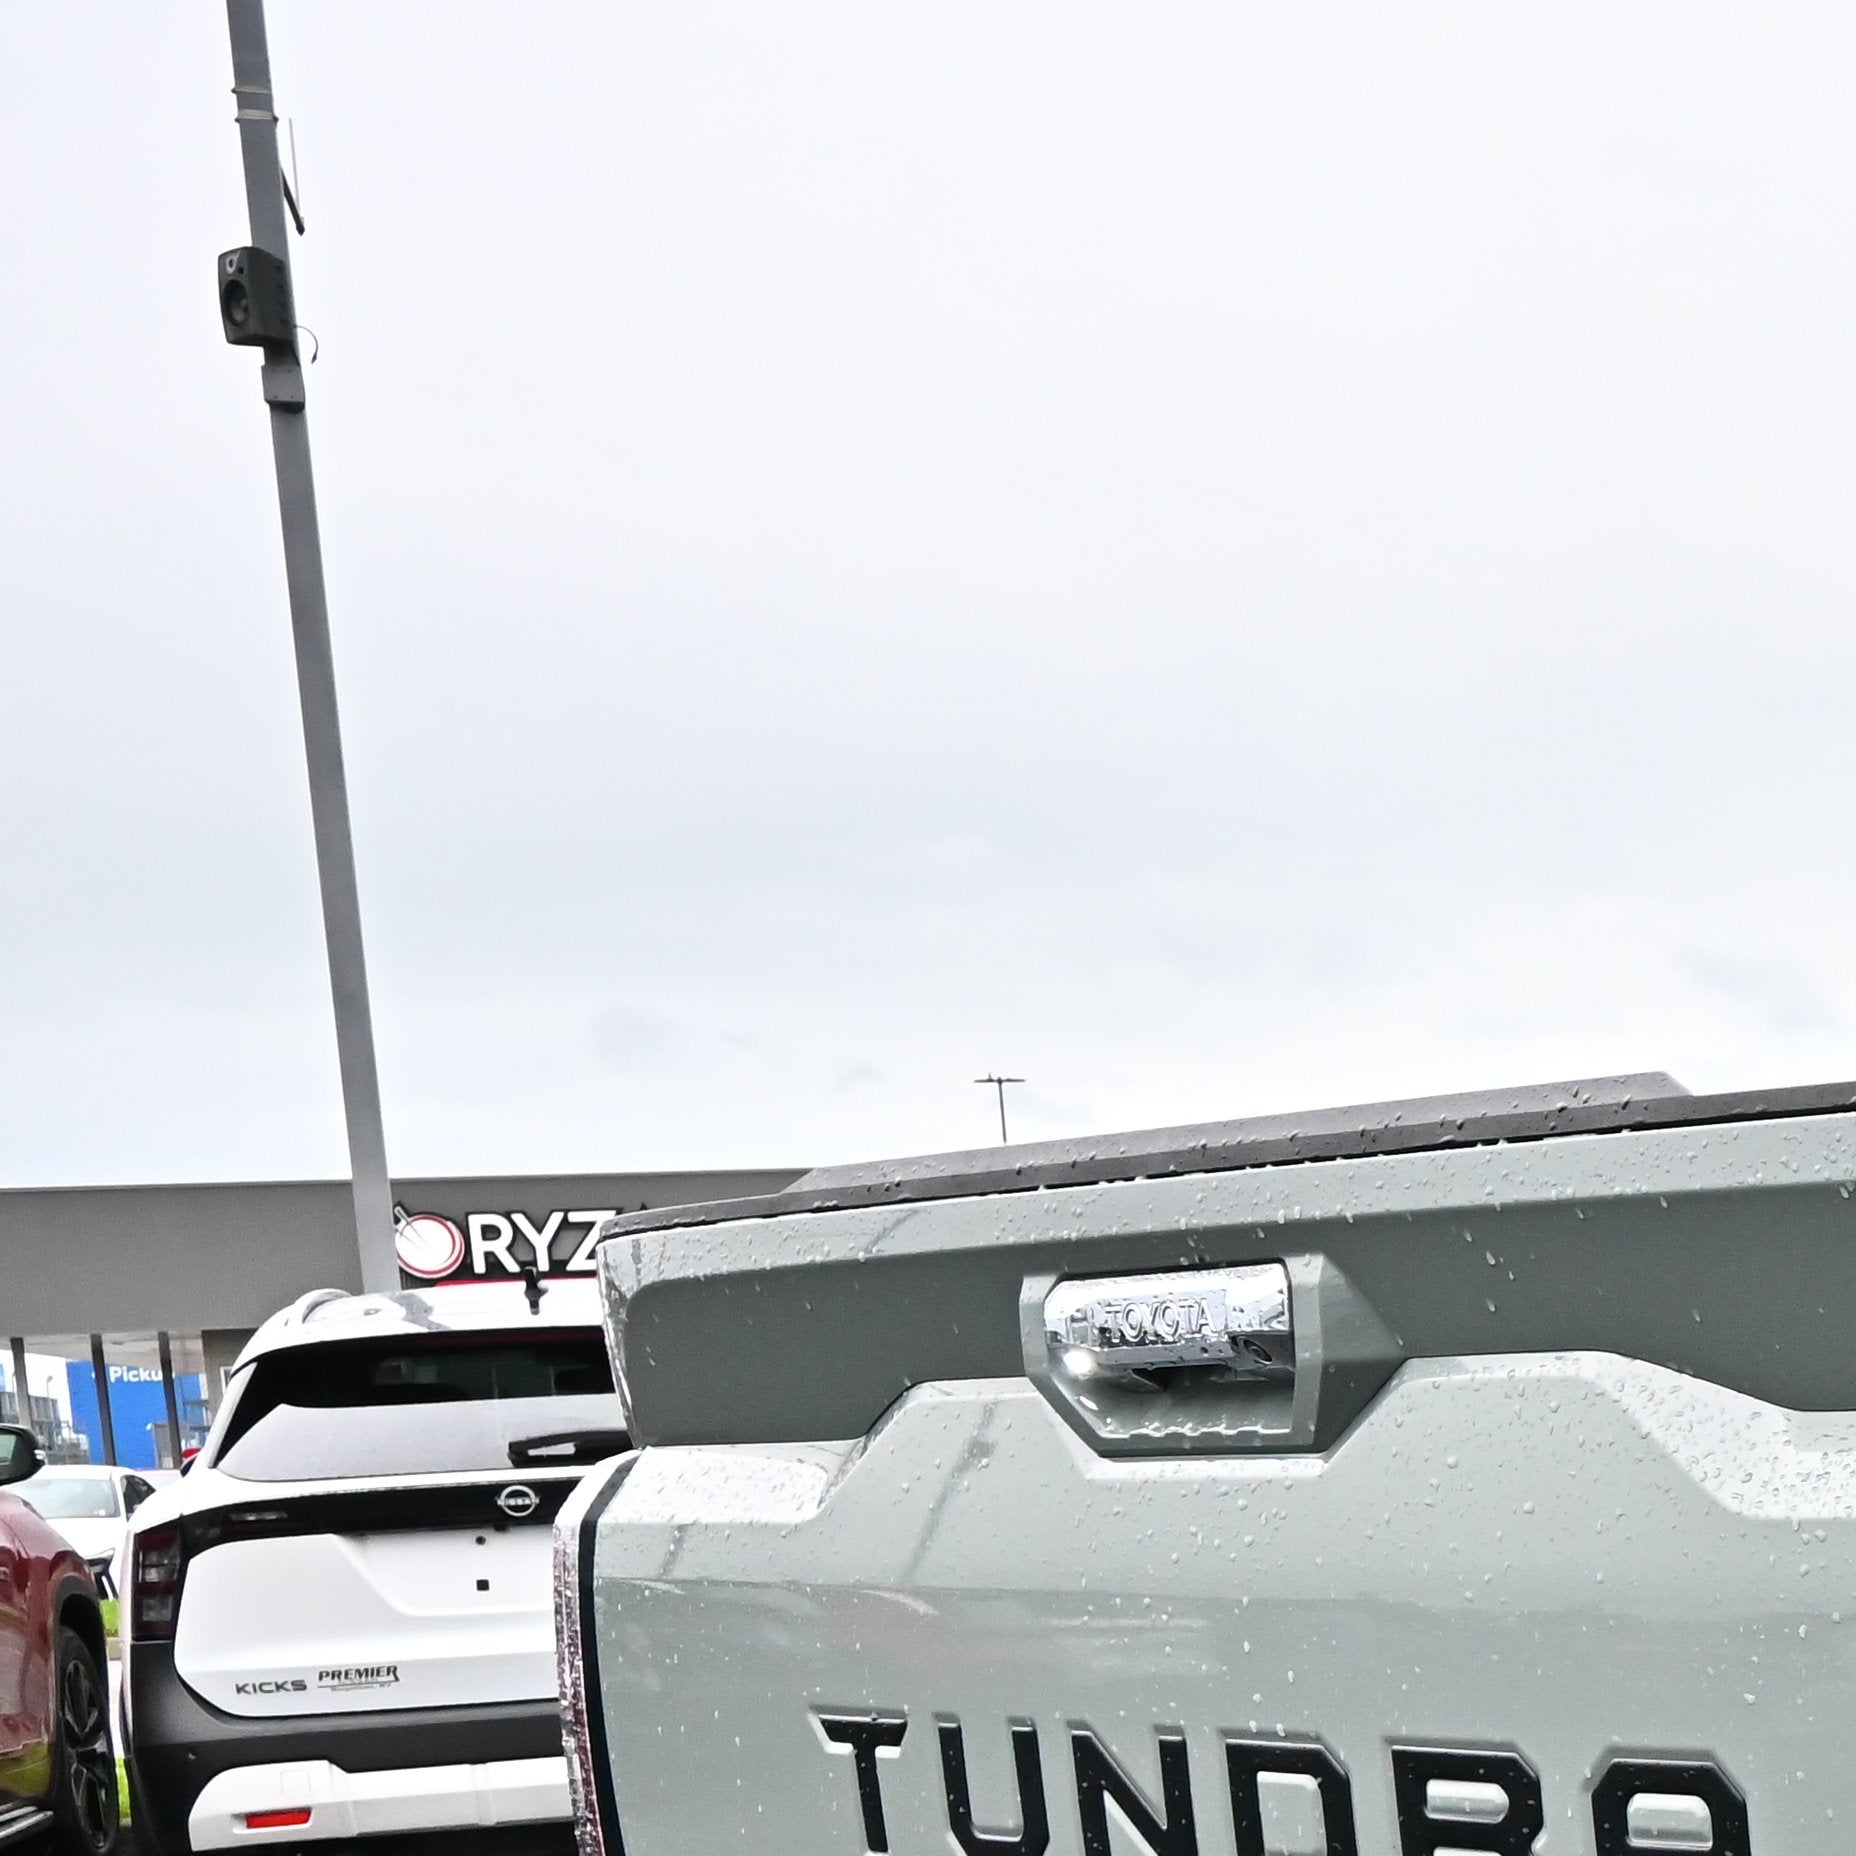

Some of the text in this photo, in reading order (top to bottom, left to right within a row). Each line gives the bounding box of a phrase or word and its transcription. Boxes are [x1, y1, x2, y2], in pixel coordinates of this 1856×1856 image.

[1104, 1296, 1217, 1344] TOYOTA
[109, 1366, 175, 1383] Picku
[318, 1665, 400, 1683] PREMIER
[235, 1679, 308, 1696] KICKS
